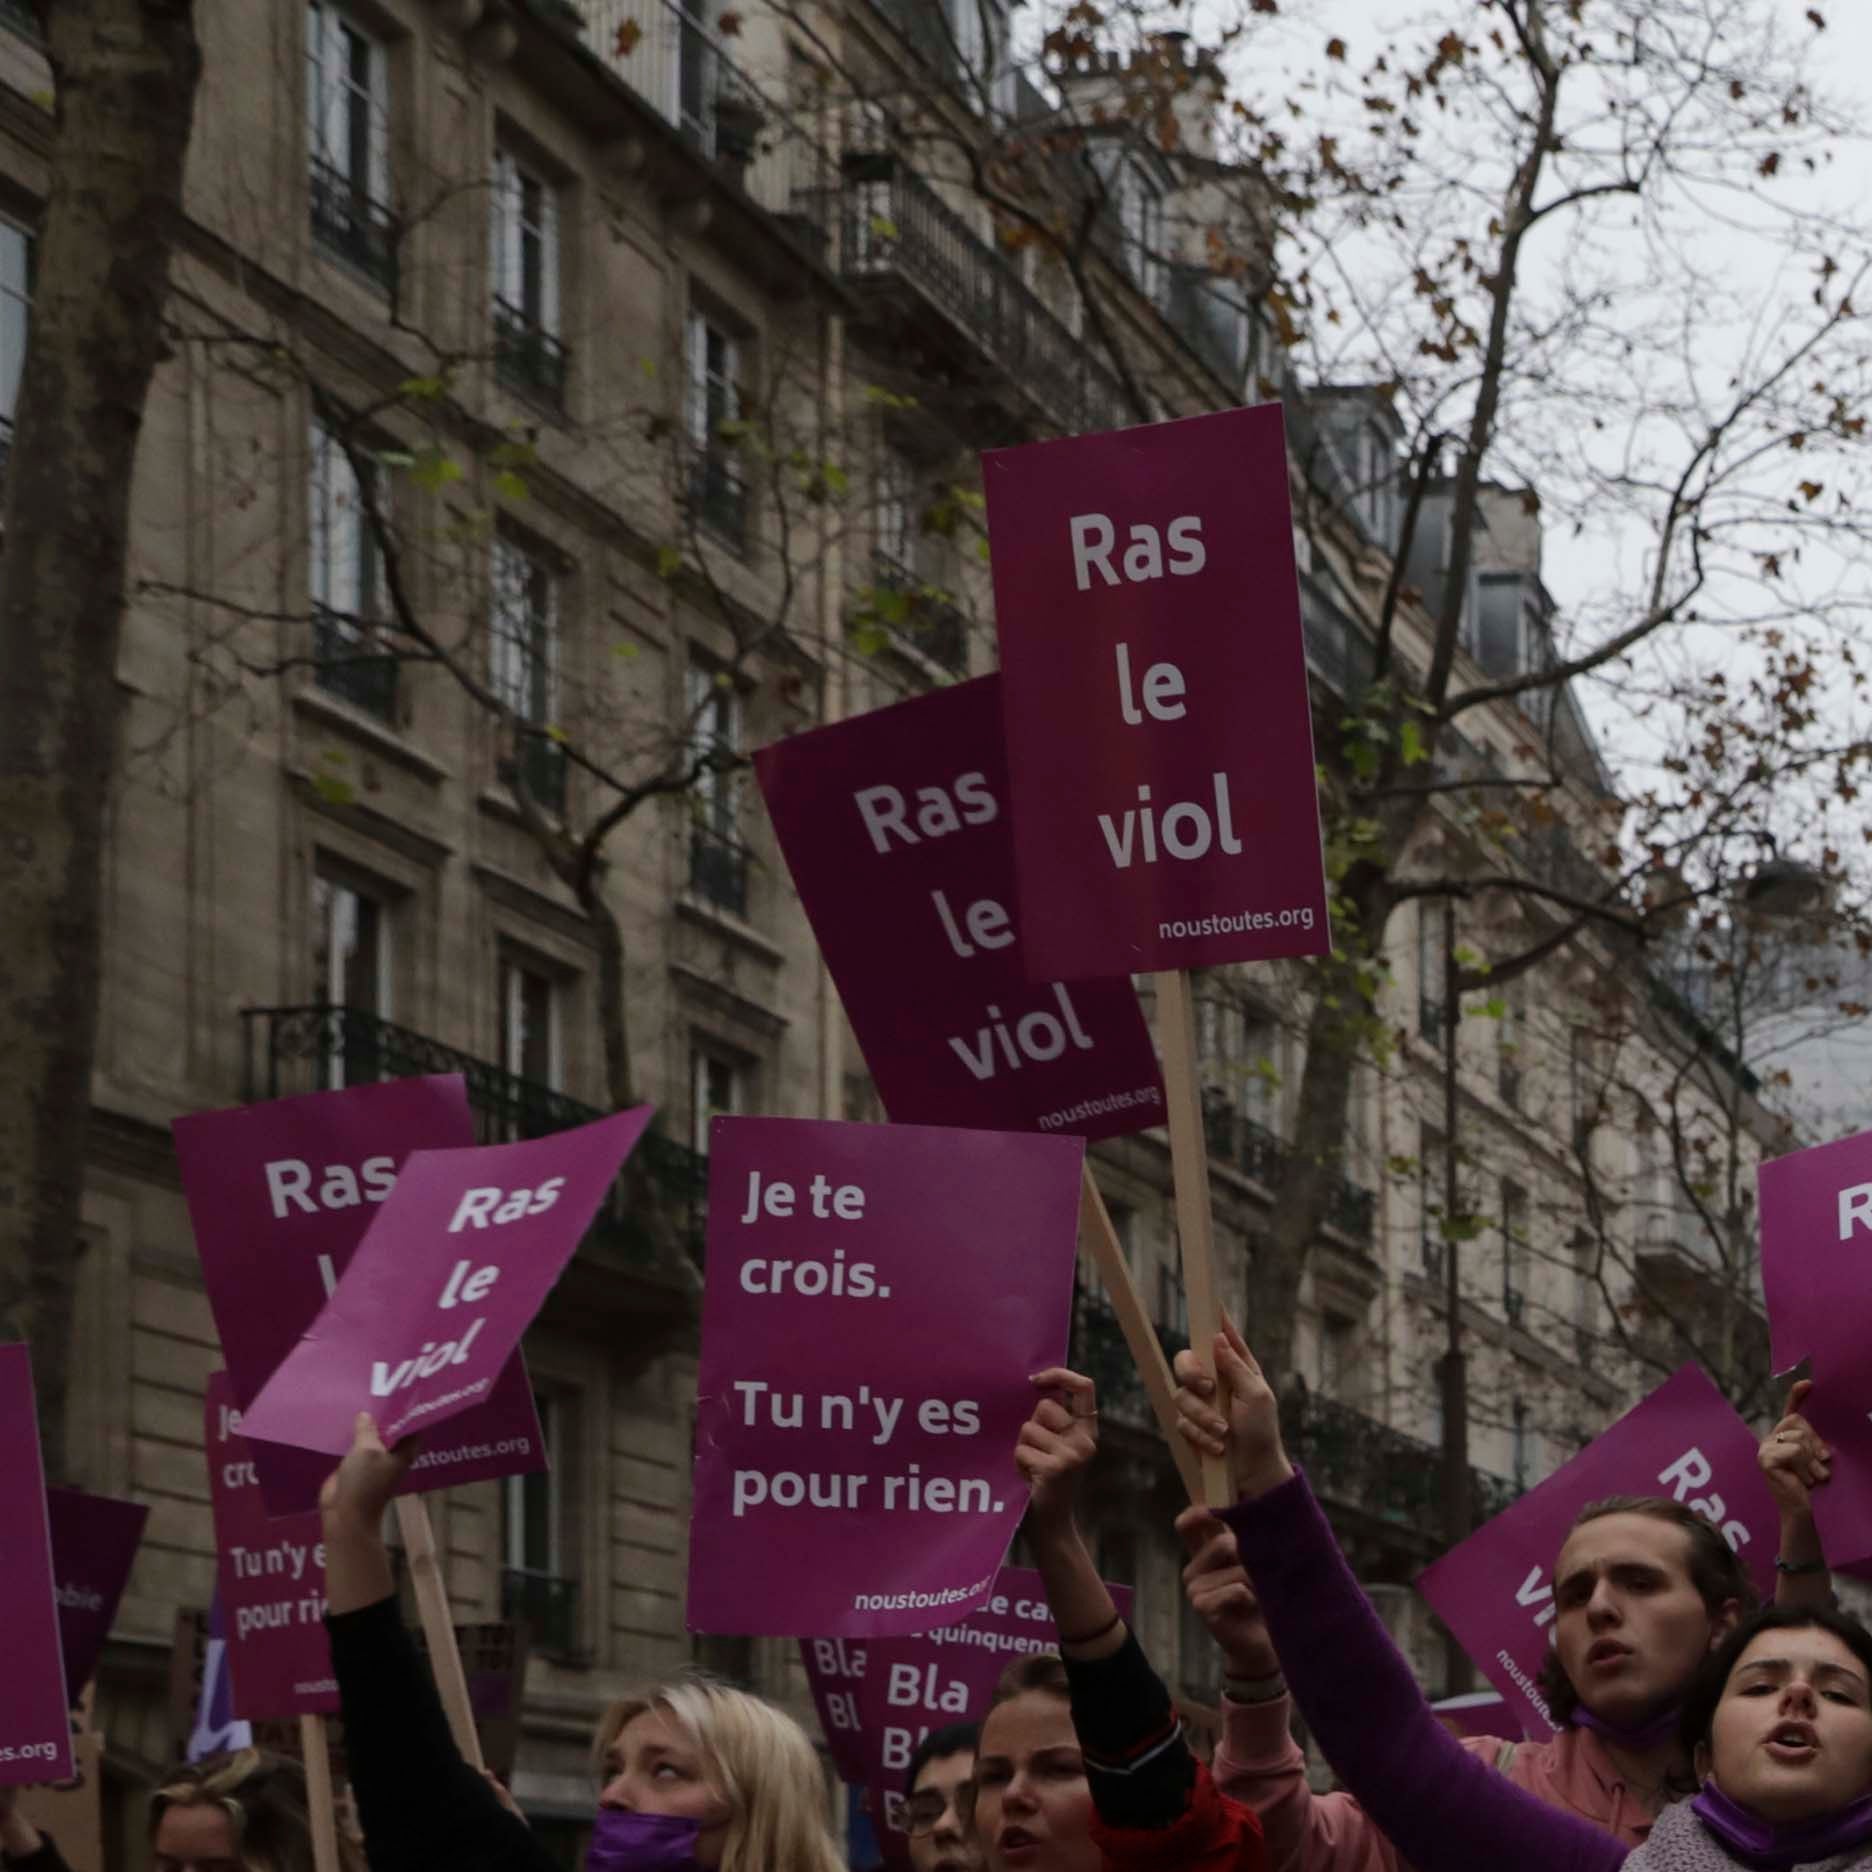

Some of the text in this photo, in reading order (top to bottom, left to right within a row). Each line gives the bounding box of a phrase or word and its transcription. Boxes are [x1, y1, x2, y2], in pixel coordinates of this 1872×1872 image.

[1070, 511, 1207, 591] Ras
[1116, 642, 1187, 726] le
[853, 770, 999, 855] Ras
[1098, 772, 1242, 869] viol
[931, 889, 1016, 958] le
[1158, 905, 1315, 941] noustoutes.org
[948, 981, 1096, 1082] viol
[1038, 1082, 1160, 1133] noustoutes.org
[264, 1156, 398, 1220] Ras
[448, 1176, 567, 1233] Ras
[740, 1170, 866, 1224] Je te
[437, 1260, 499, 1310] le
[740, 1249, 891, 1298] crois.
[370, 1317, 487, 1397] viol
[734, 1381, 981, 1445] Tu n'y es
[733, 1464, 1004, 1516] pour rien.
[230, 1547, 262, 1578] Tu
[266, 1540, 307, 1580] n'y
[235, 1602, 293, 1640] pour
[825, 1692, 862, 1731] Bl
[887, 1662, 969, 1714] Bla
